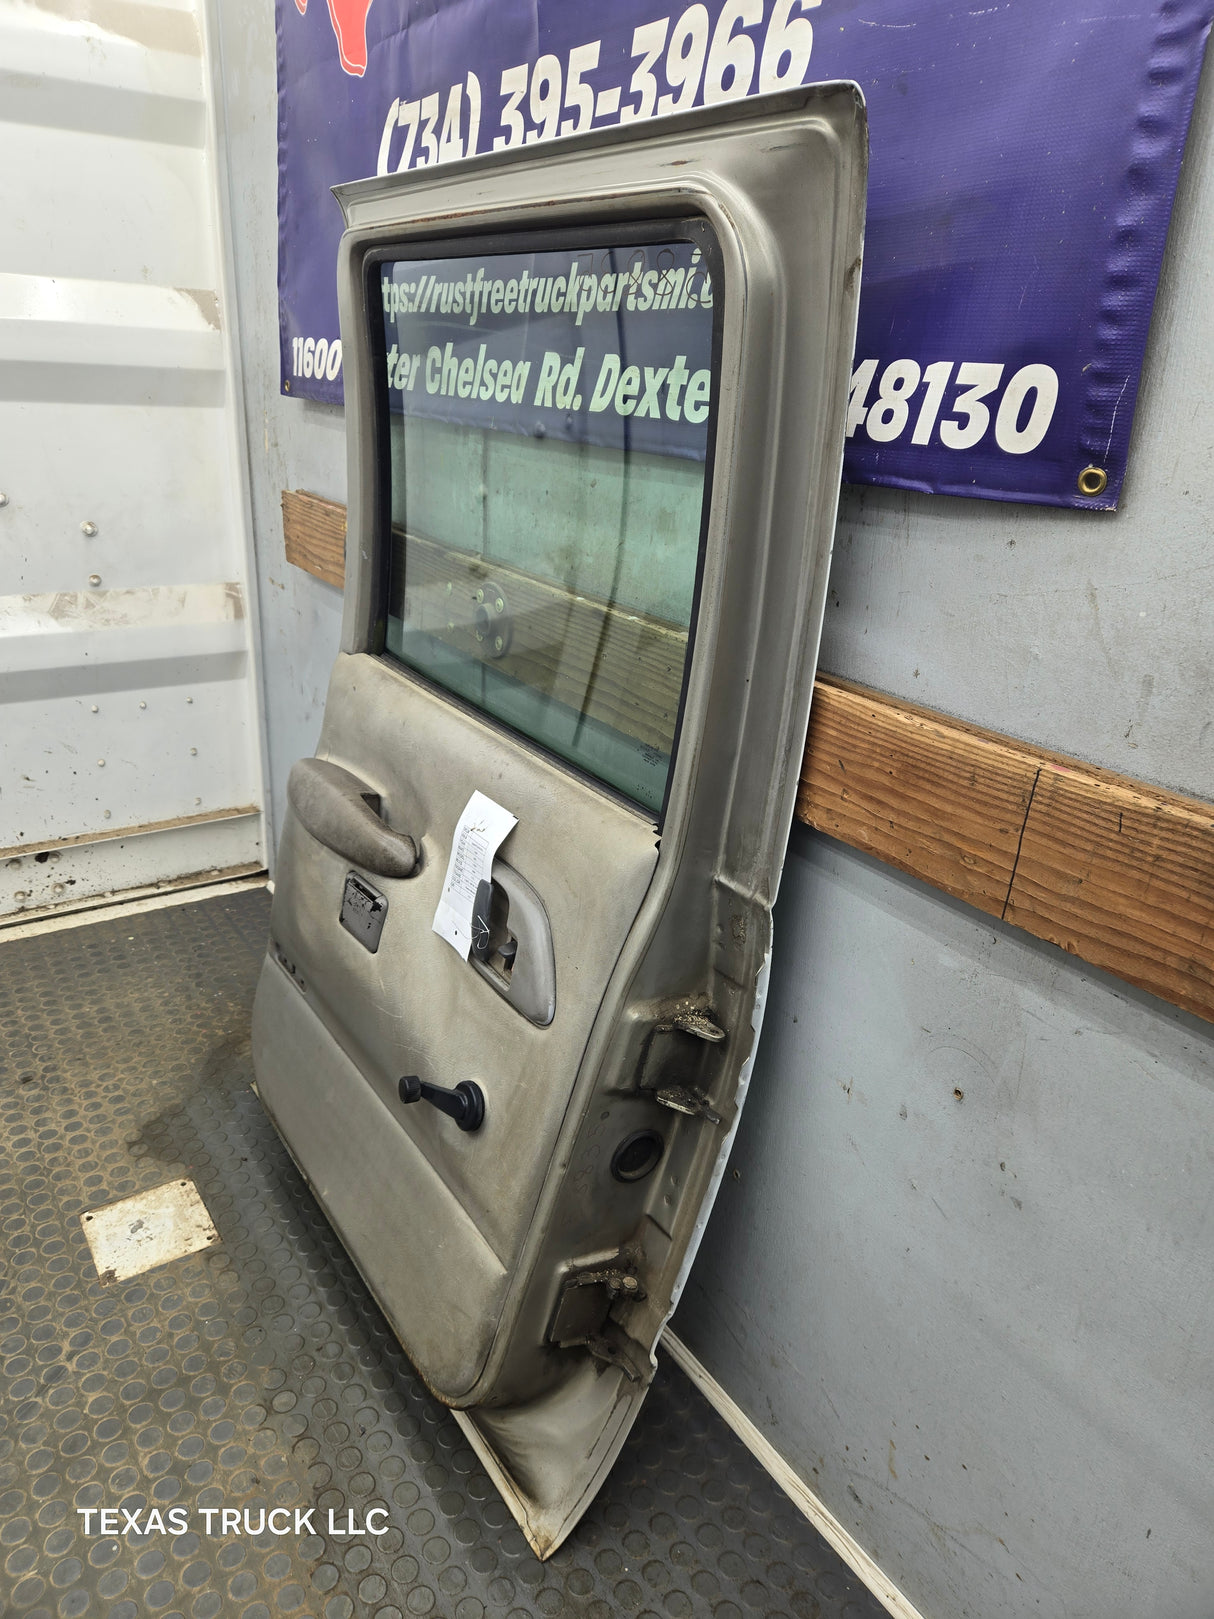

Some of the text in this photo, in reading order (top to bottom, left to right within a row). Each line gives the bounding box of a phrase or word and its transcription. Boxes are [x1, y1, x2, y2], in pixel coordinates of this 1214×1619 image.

[377, 0, 821, 176] (734) 395-3966
[292, 336, 343, 381] 11600
[425, 342, 532, 404] Chelsea
[533, 347, 586, 411] Rd.
[588, 353, 712, 424] Dexte
[845, 359, 1059, 455] 48130
